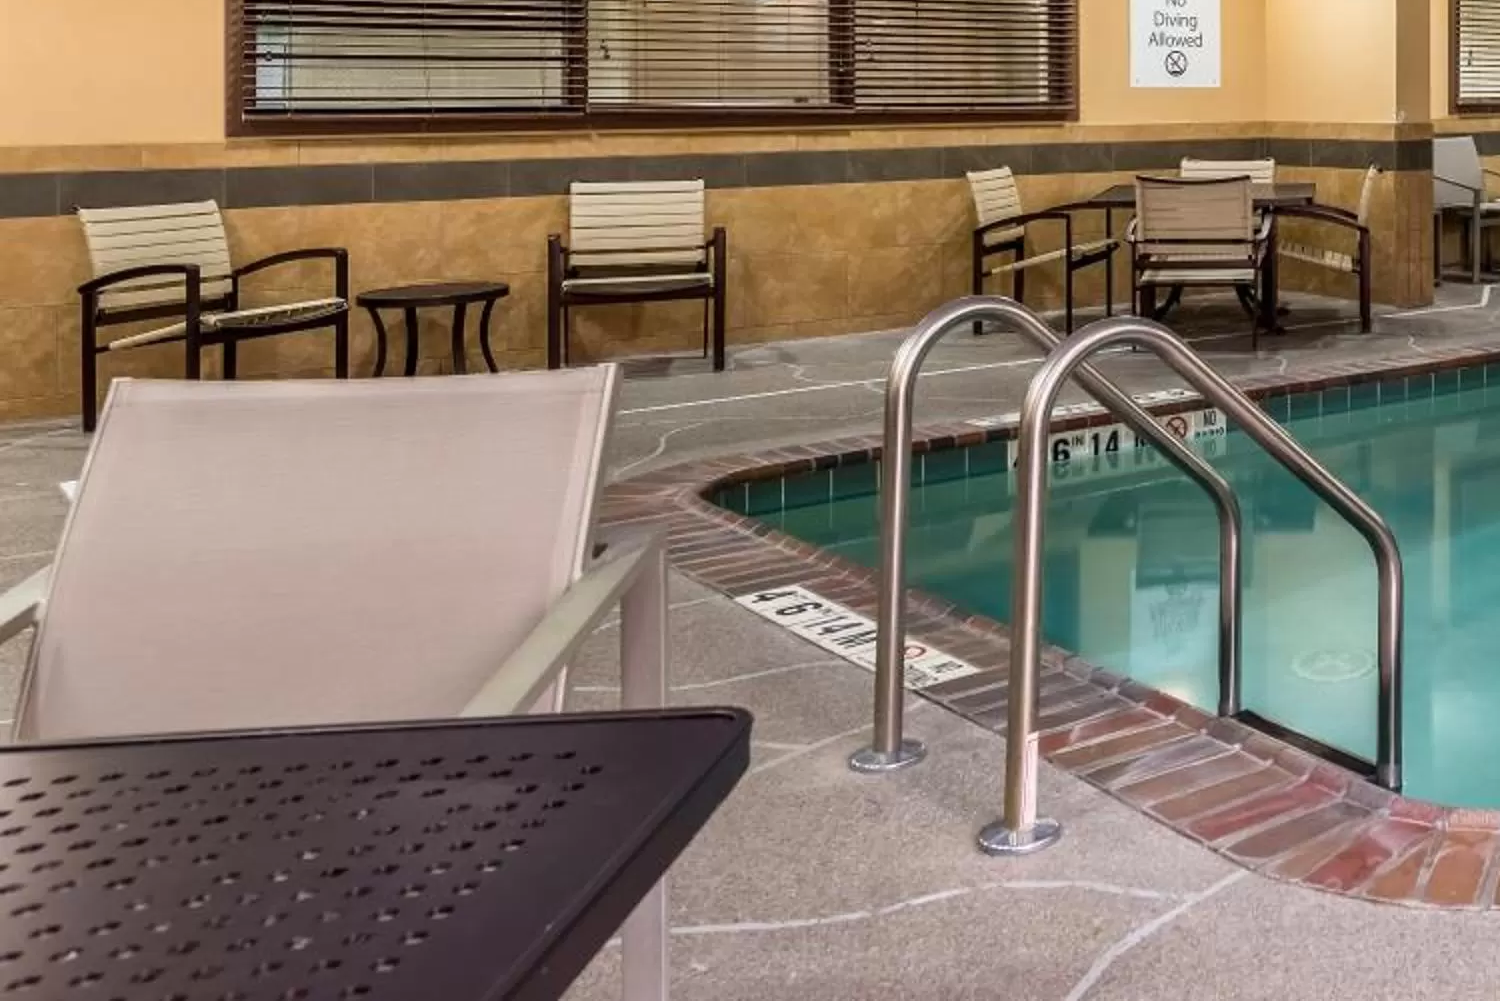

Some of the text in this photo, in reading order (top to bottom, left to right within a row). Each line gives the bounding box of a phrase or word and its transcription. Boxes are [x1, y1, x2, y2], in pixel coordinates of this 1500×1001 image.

[1153, 10, 1198, 32] Diving
[1147, 31, 1203, 48] Allowed
[1203, 410, 1217, 426] NO
[1053, 437, 1071, 462] 6
